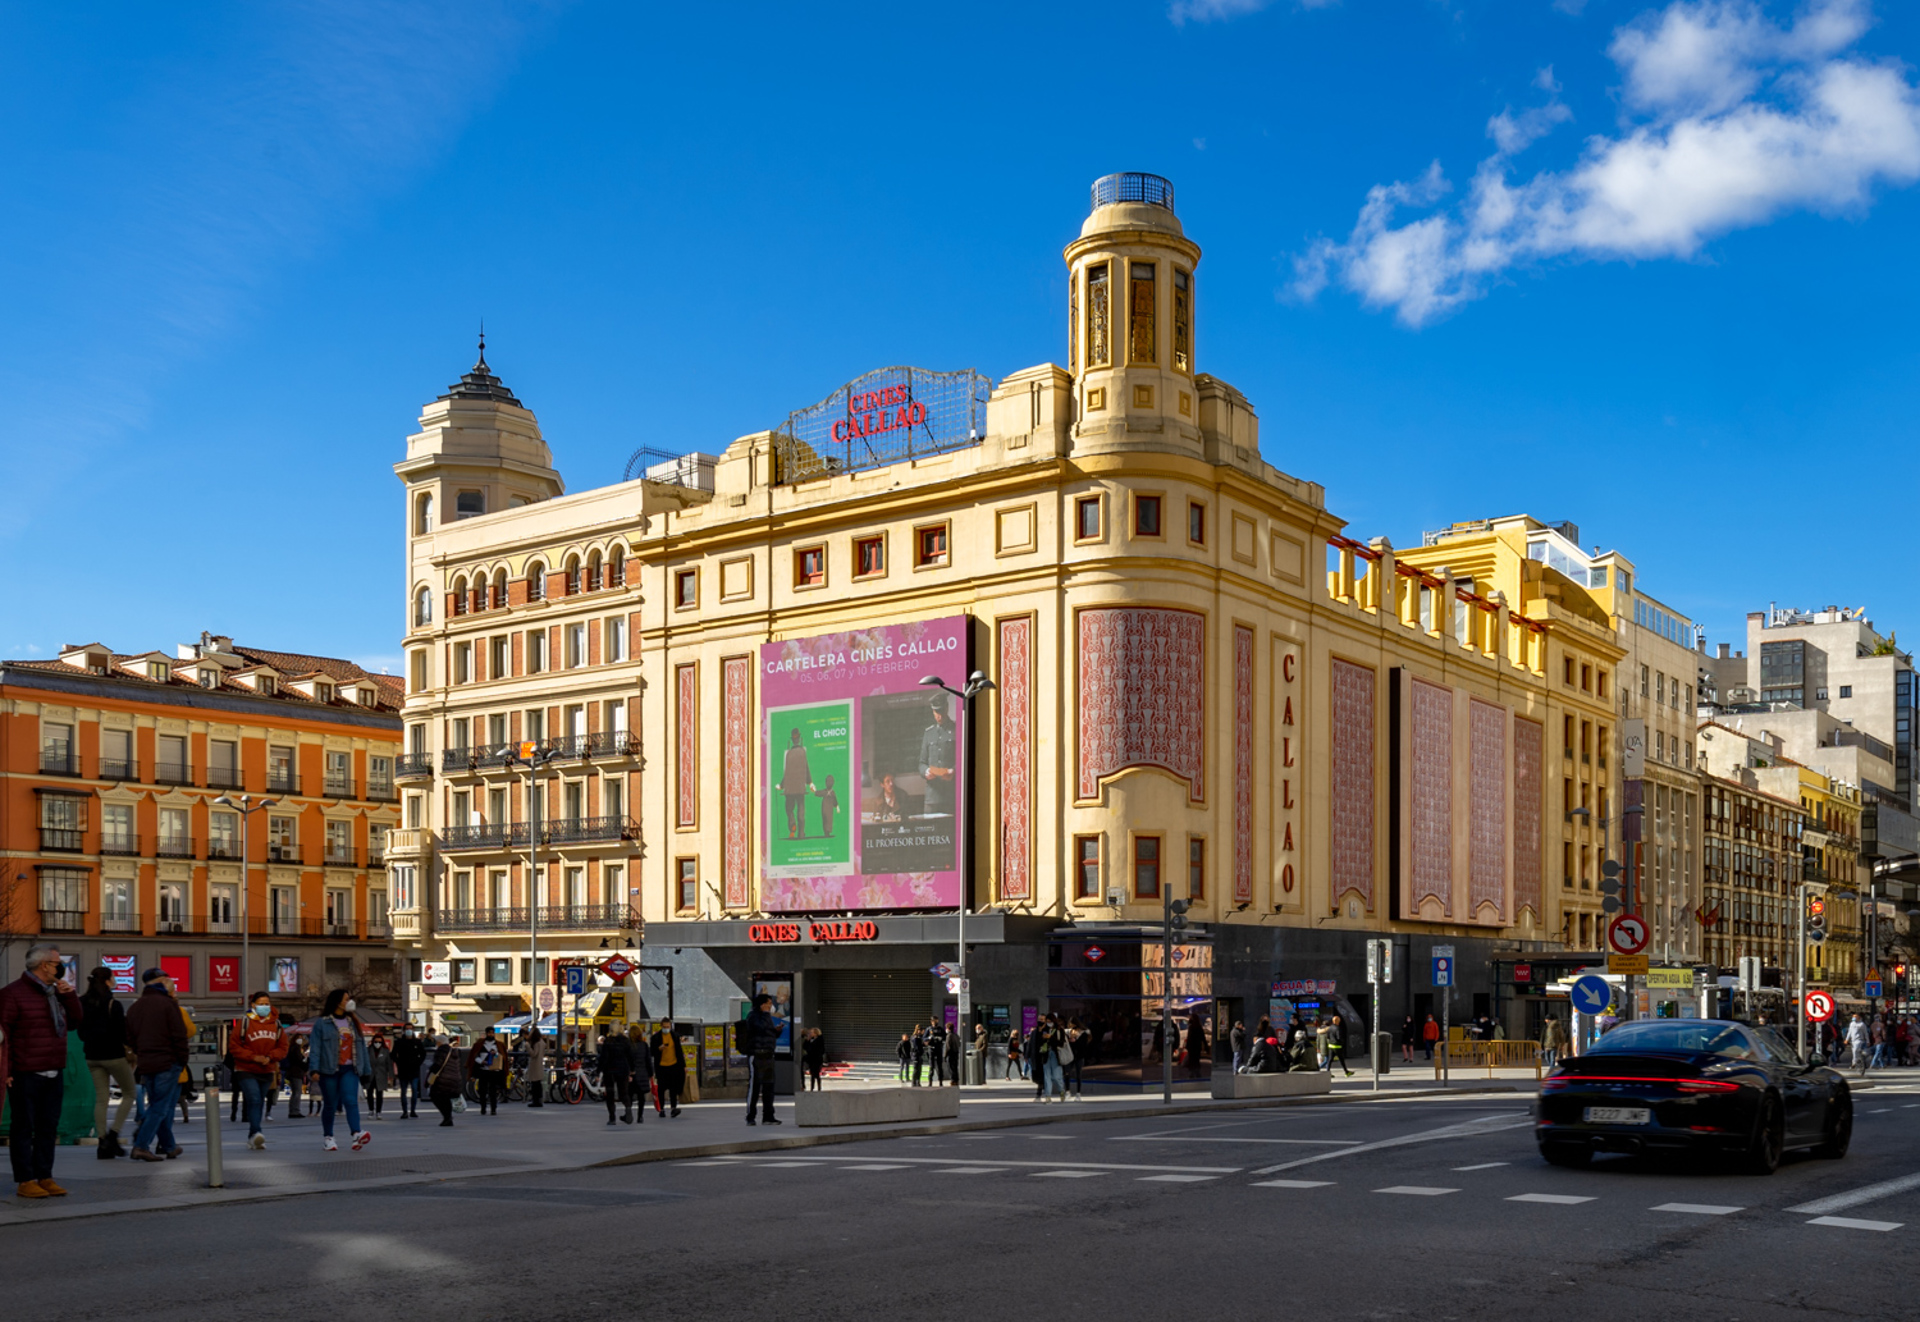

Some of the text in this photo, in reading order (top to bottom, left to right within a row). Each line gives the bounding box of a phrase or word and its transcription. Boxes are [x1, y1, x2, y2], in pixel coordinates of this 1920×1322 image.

[849, 384, 907, 414] CINES
[831, 402, 926, 443] CALLAO
[766, 636, 957, 674] CARTELERA CINES CALLAO
[857, 666, 867, 676] 10
[870, 658, 919, 674] FEBRERO
[813, 727, 847, 738] EL CHICO
[1282, 653, 1295, 893] CALLAO
[866, 835, 951, 848] EL PROFESOR DE PERSA
[748, 921, 876, 942] CINES CALLAO
[569, 971, 579, 991] P
[1272, 981, 1303, 991] AGUA
[1669, 973, 1680, 984] AGUA
[1272, 989, 1306, 997] FRIA
